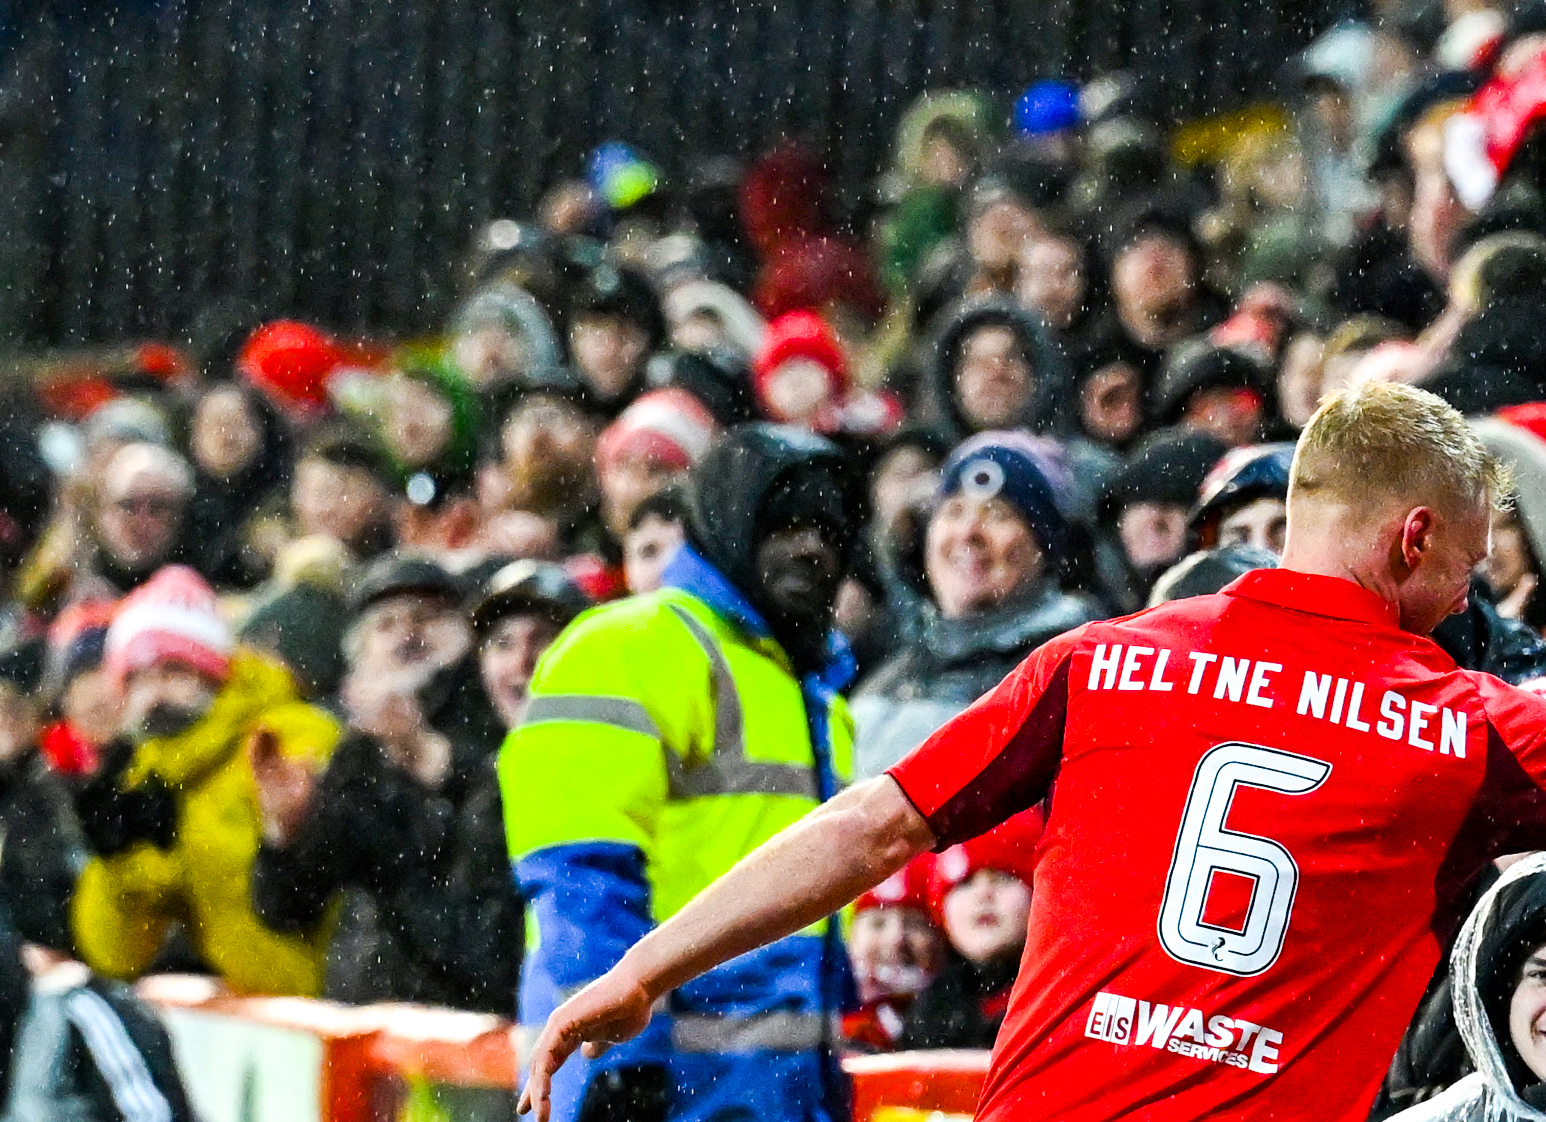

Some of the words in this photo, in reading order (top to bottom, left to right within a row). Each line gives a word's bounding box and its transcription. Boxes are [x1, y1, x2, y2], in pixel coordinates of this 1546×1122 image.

[1087, 643, 1284, 709] HELTNE
[1295, 670, 1468, 759] NILSEN
[1156, 740, 1334, 978] 6
[1133, 999, 1284, 1074] WASTE
[1166, 1037, 1249, 1070] SERVICES
